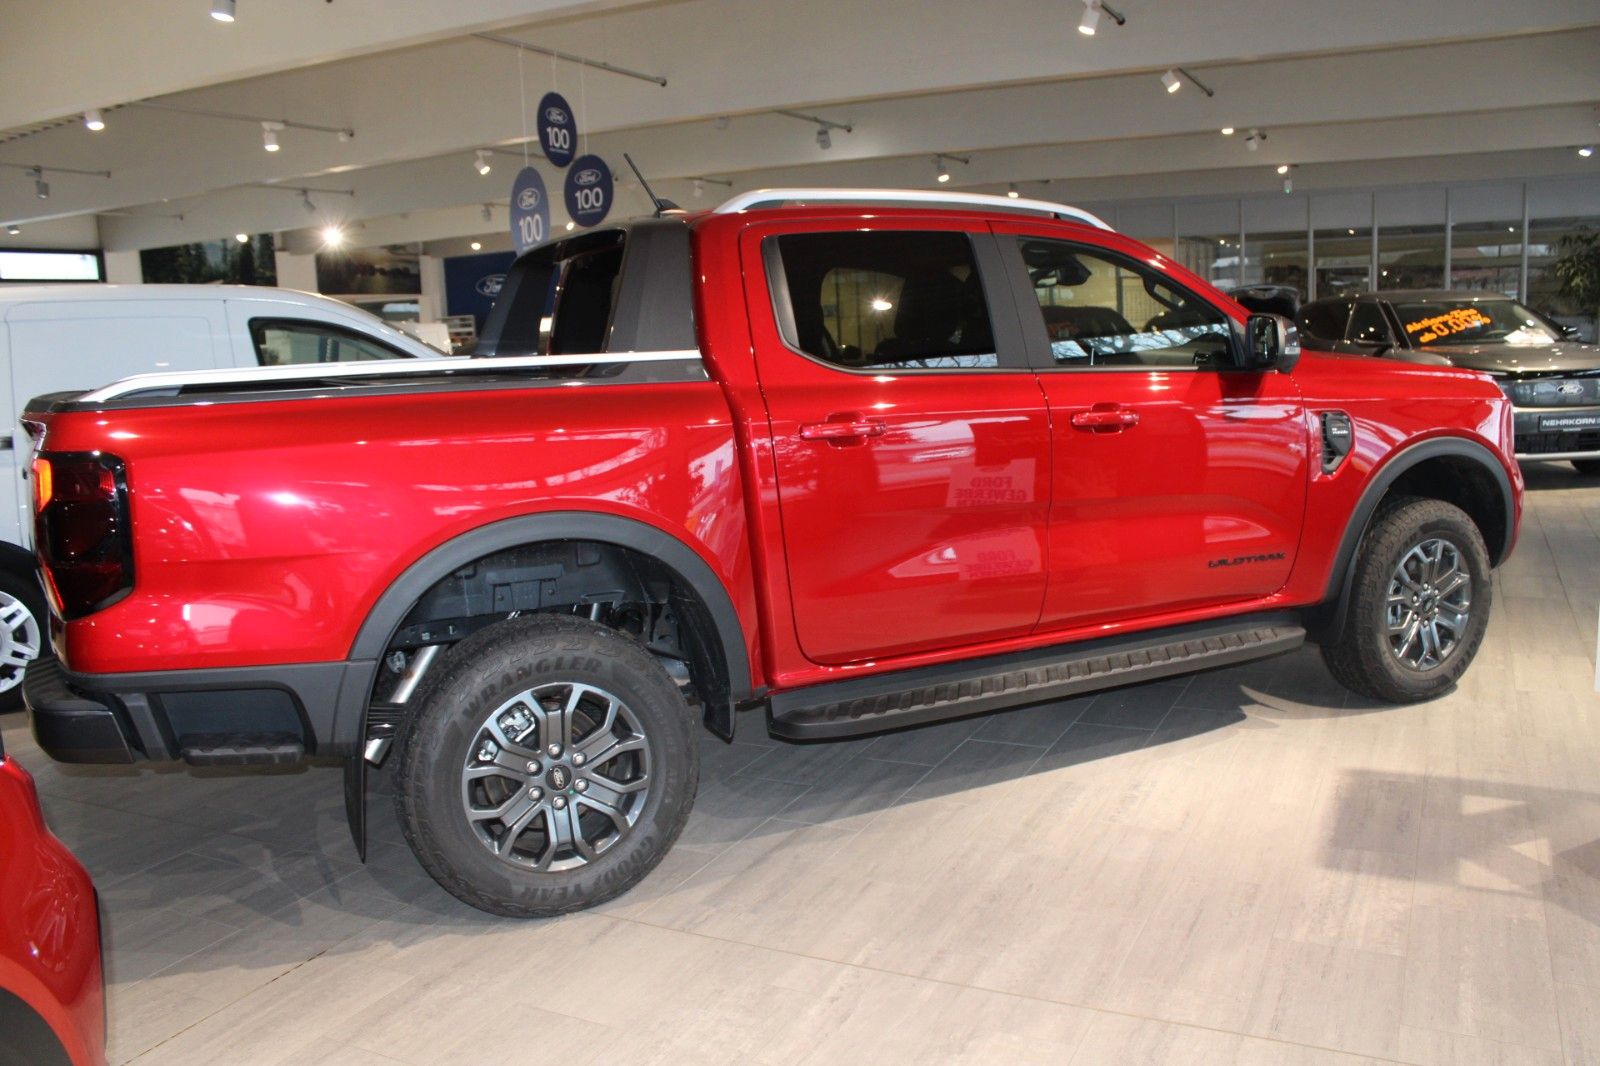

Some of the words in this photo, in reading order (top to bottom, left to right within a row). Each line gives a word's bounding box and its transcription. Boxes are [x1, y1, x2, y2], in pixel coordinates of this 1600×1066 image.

[546, 126, 570, 149] 100
[575, 187, 603, 209] 100
[519, 214, 543, 243] 100
[463, 656, 603, 721] WRANGLER
